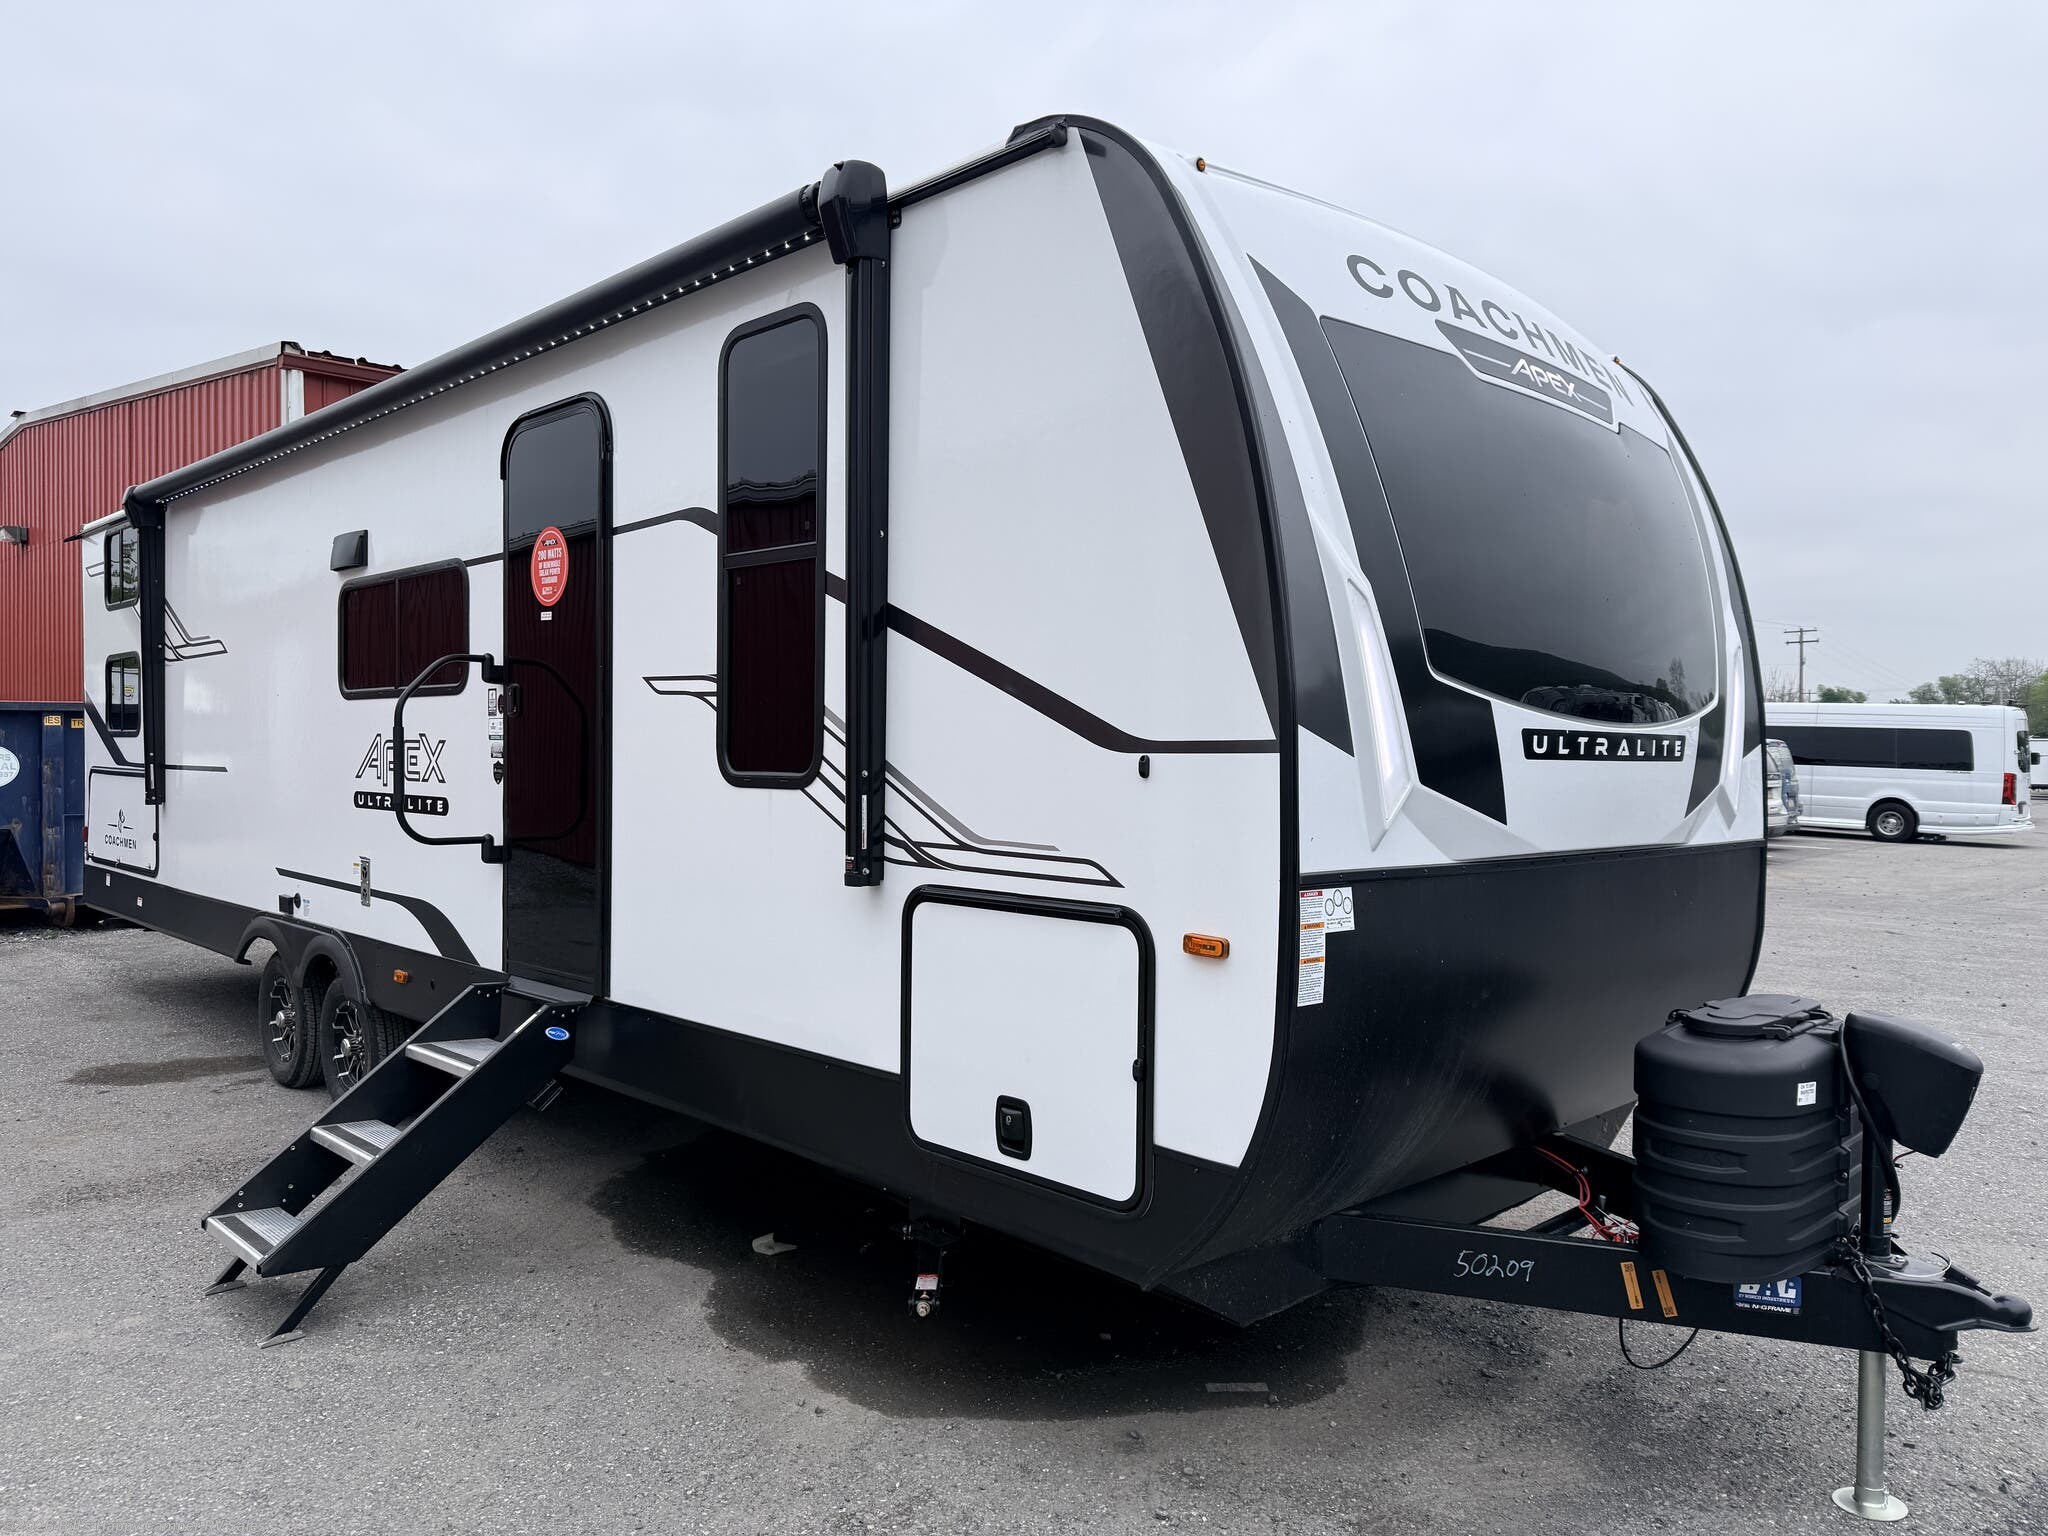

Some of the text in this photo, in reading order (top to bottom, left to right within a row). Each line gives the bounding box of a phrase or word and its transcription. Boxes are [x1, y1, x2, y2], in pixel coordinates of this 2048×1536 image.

[1346, 254, 1635, 407] COACHMEN
[1511, 358, 1583, 402] APEX
[548, 548, 562, 559] WATTS
[1533, 735, 1682, 757] ULTRALITE
[357, 794, 444, 813] ULTRLITE
[105, 834, 137, 850] COACHMEN
[1453, 1250, 1535, 1282] 50209
